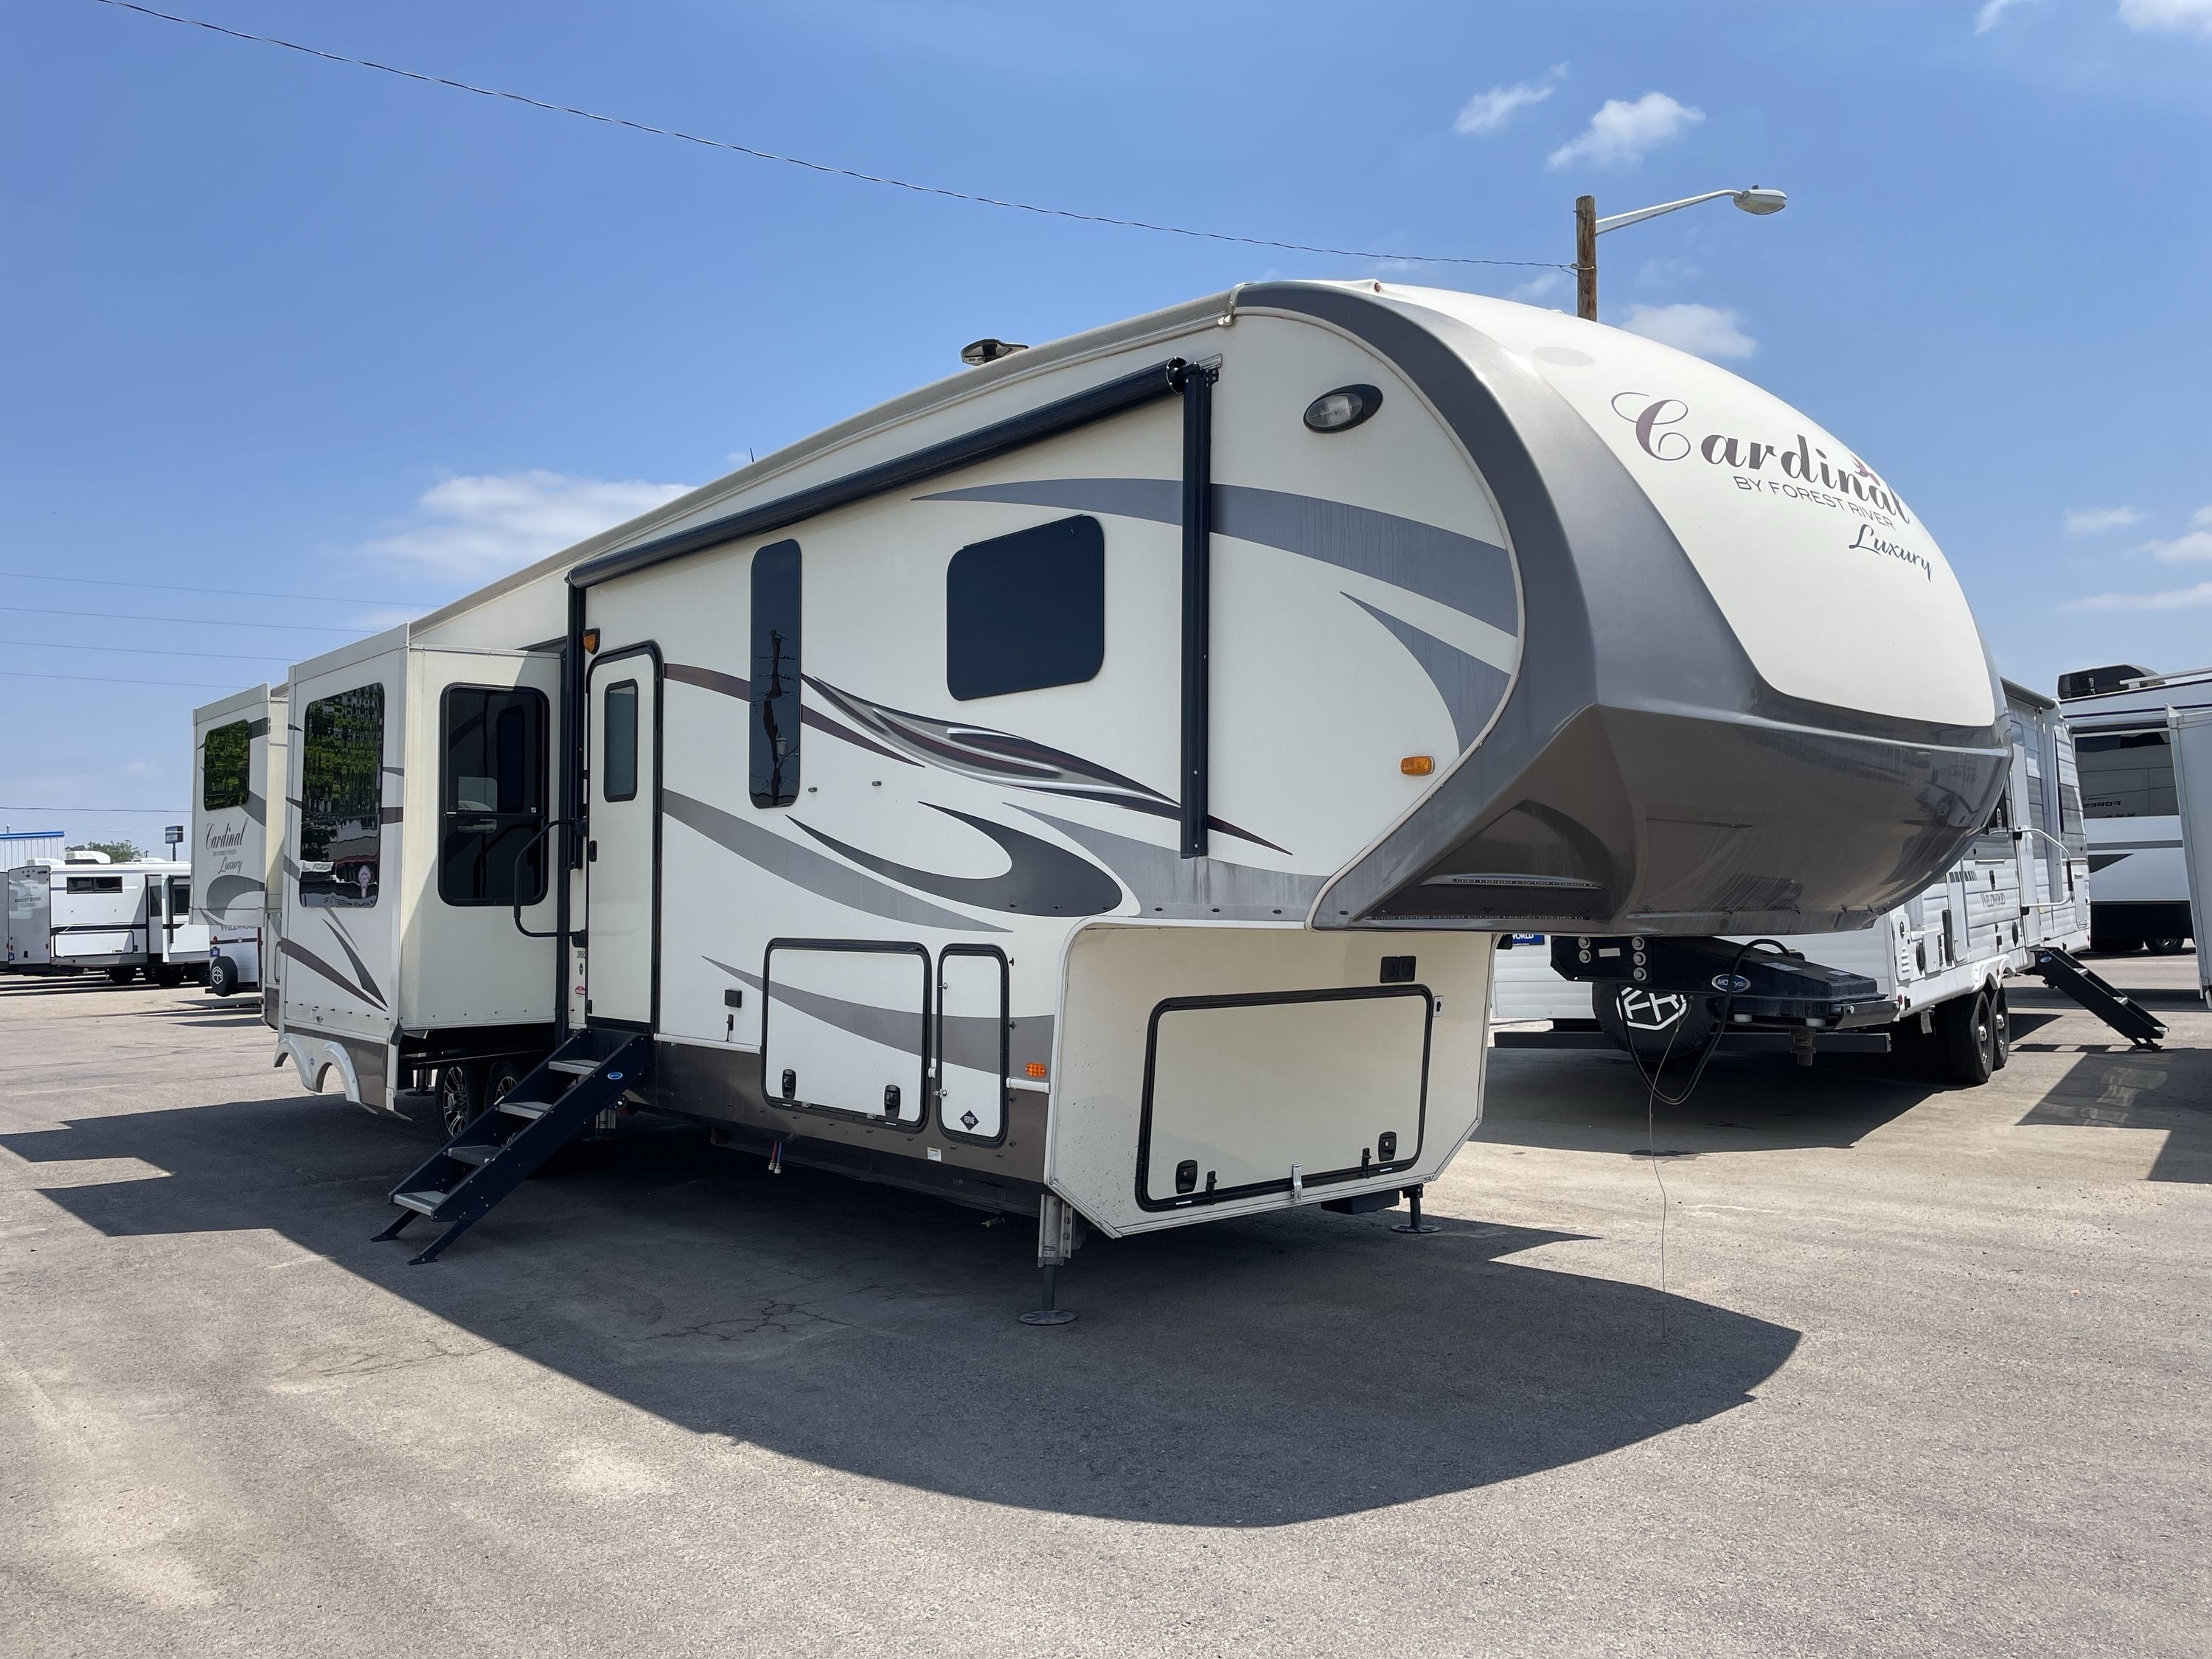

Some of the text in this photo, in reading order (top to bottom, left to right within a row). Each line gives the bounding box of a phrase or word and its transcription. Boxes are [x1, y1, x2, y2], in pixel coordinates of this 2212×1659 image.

[1611, 392, 1910, 524] Cardinal
[1733, 476, 1897, 531] BY FOREST RIVER
[1848, 524, 1933, 582] Luxury
[206, 816, 249, 849] Cardinal
[218, 856, 243, 874] Luxury
[1980, 892, 2006, 908] WILDWOOD
[1717, 978, 1746, 988] MOyde
